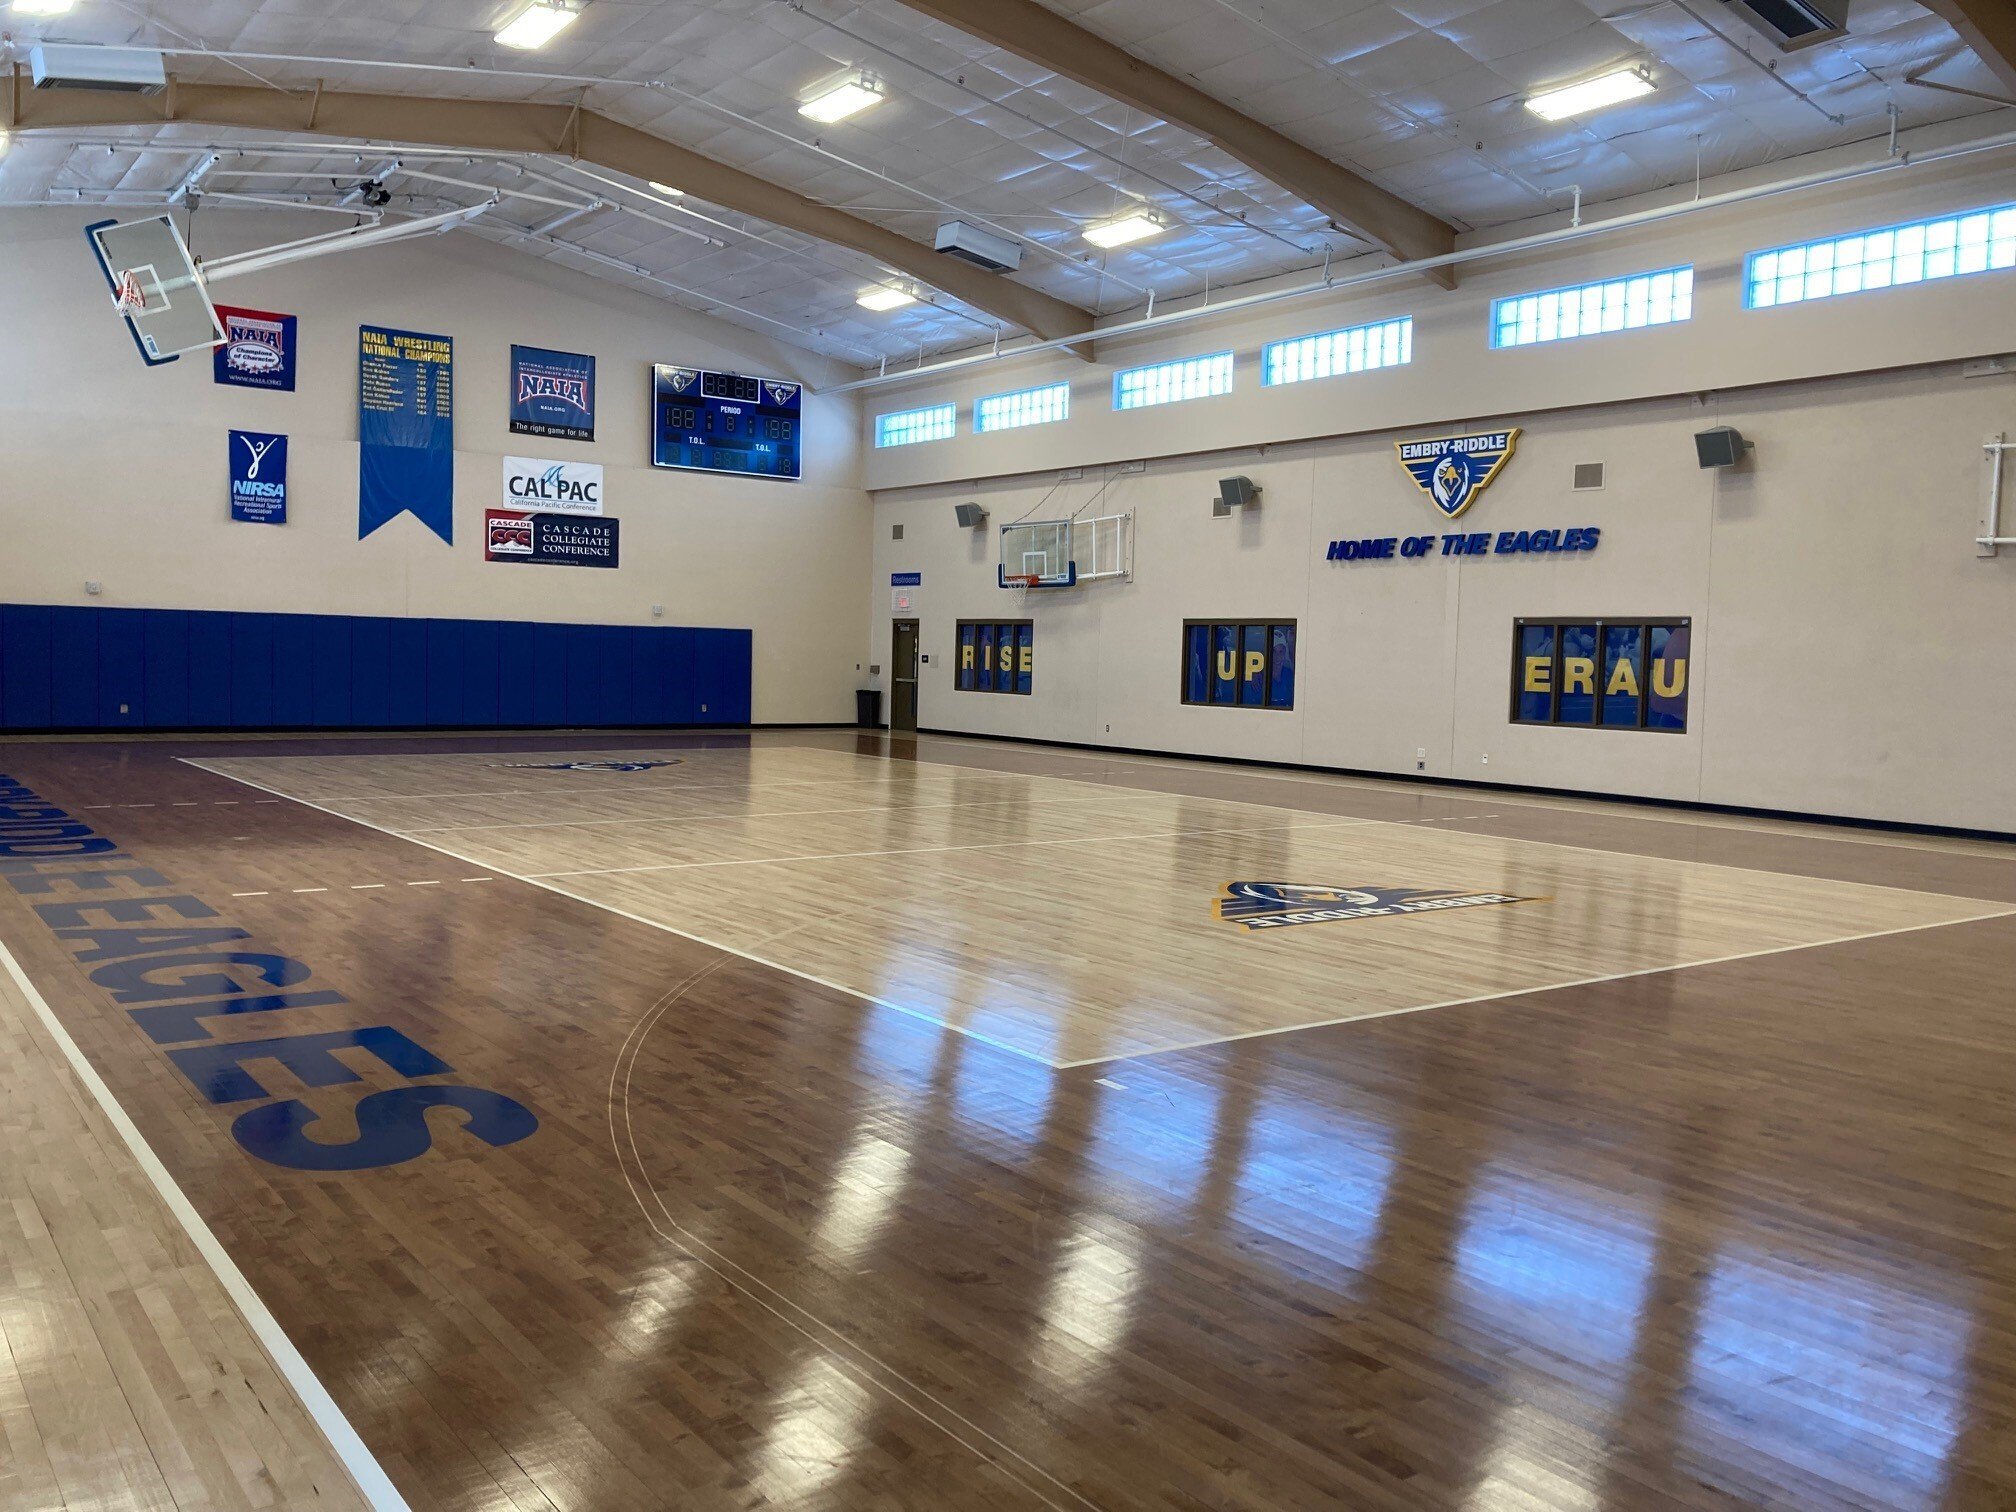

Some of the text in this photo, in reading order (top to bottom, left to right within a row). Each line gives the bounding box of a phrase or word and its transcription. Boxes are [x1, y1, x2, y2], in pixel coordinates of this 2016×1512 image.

[230, 327, 279, 351] NAIA
[362, 331, 450, 352] NAIA WRESTLING
[236, 347, 273, 356] Champions
[362, 343, 450, 364] NATIONAL CHAMPIONS
[242, 355, 276, 363] Character
[519, 361, 544, 369] NATIONAL
[546, 365, 579, 373] ASSOCIATION
[228, 374, 282, 386] WWW.NAIA.ORG
[519, 373, 586, 410] NAIA
[540, 405, 566, 413] NAIA.ORG
[720, 405, 742, 415] PERIOD
[516, 422, 588, 437] The right game for life
[689, 436, 706, 445] T.O.L.
[1401, 434, 1506, 459] EMBRY-RIDDLE
[755, 444, 771, 452] T.O.L.
[233, 480, 284, 497] NIRSA
[509, 476, 597, 502] CAL PAC
[234, 500, 282, 510] Recreational Sports
[243, 507, 273, 515] Association
[510, 499, 596, 511] California Pacific Conference
[490, 520, 532, 528] CASCADE
[542, 524, 610, 537] CASCADE
[542, 534, 610, 547] COLLEGIATE
[1326, 527, 1600, 560] HOME OF THE EAGLES
[542, 544, 610, 557] CONFERENCE
[892, 575, 920, 584] Restrooms
[962, 645, 1032, 672] RISE
[1217, 650, 1265, 681] UP
[1525, 656, 1686, 698] ERAU
[31, 895, 539, 1172] EAGLES
